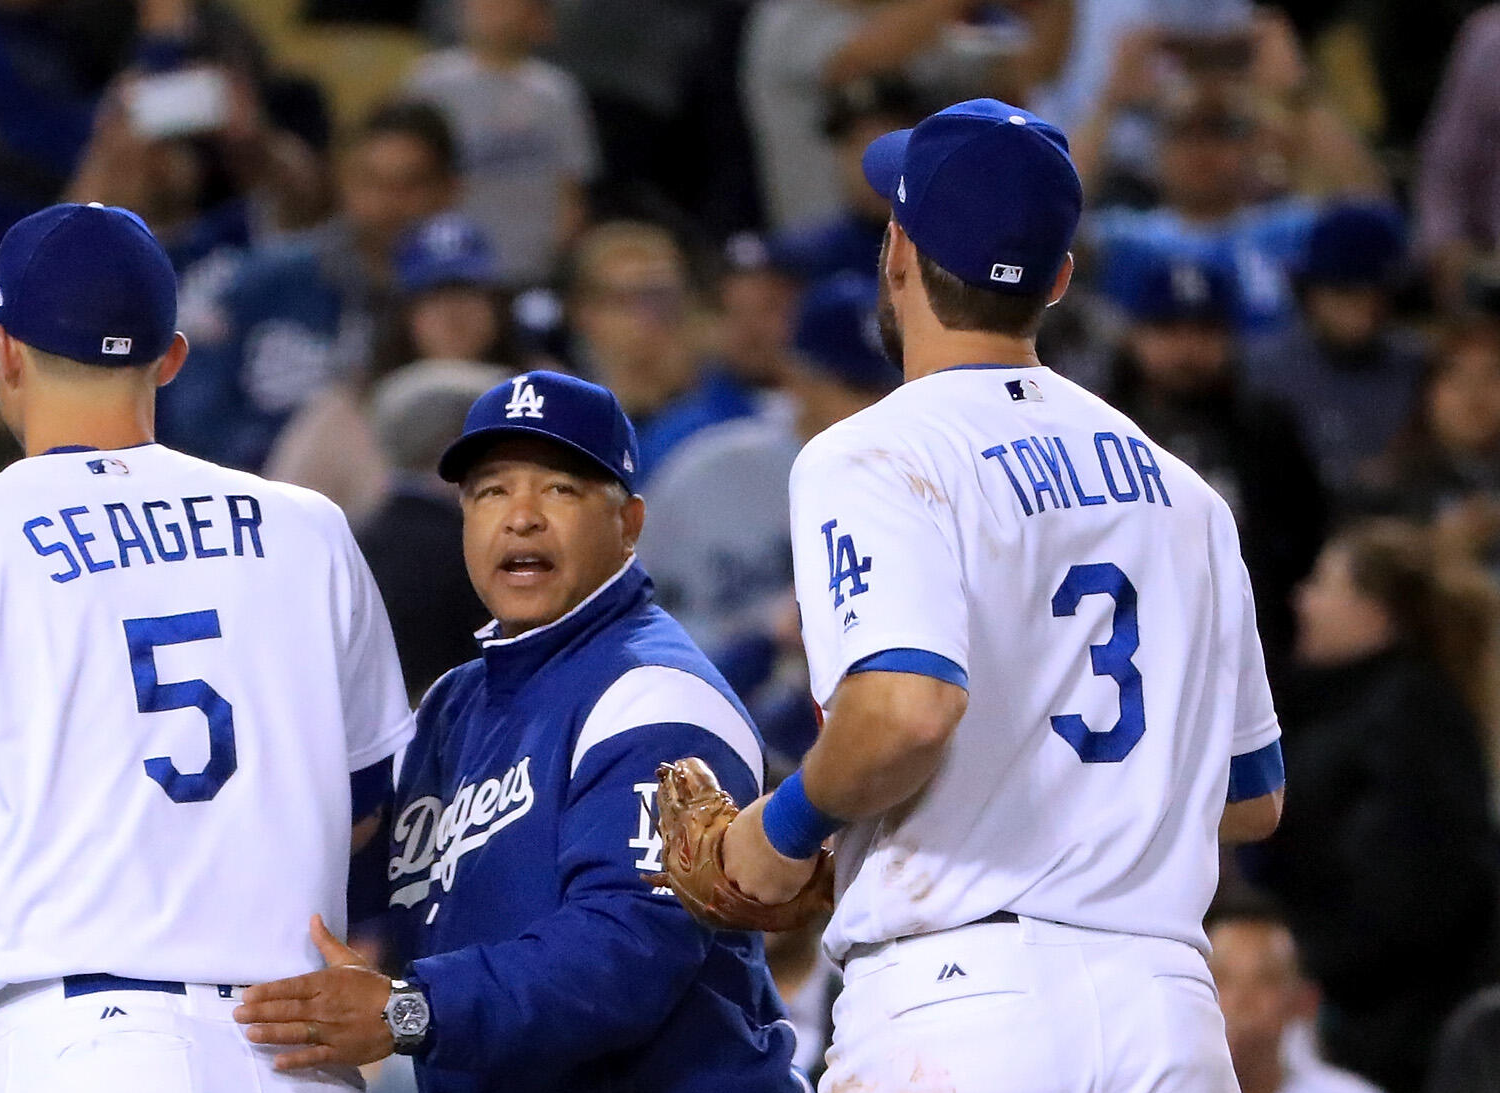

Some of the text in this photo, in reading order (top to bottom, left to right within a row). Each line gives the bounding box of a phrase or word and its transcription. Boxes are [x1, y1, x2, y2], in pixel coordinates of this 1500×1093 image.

[505, 376, 545, 419] LA
[981, 431, 1172, 517] TAYLOR
[22, 494, 265, 583] SEAGER
[820, 518, 872, 611] LA
[122, 608, 237, 804] 5
[1049, 562, 1147, 763] 3
